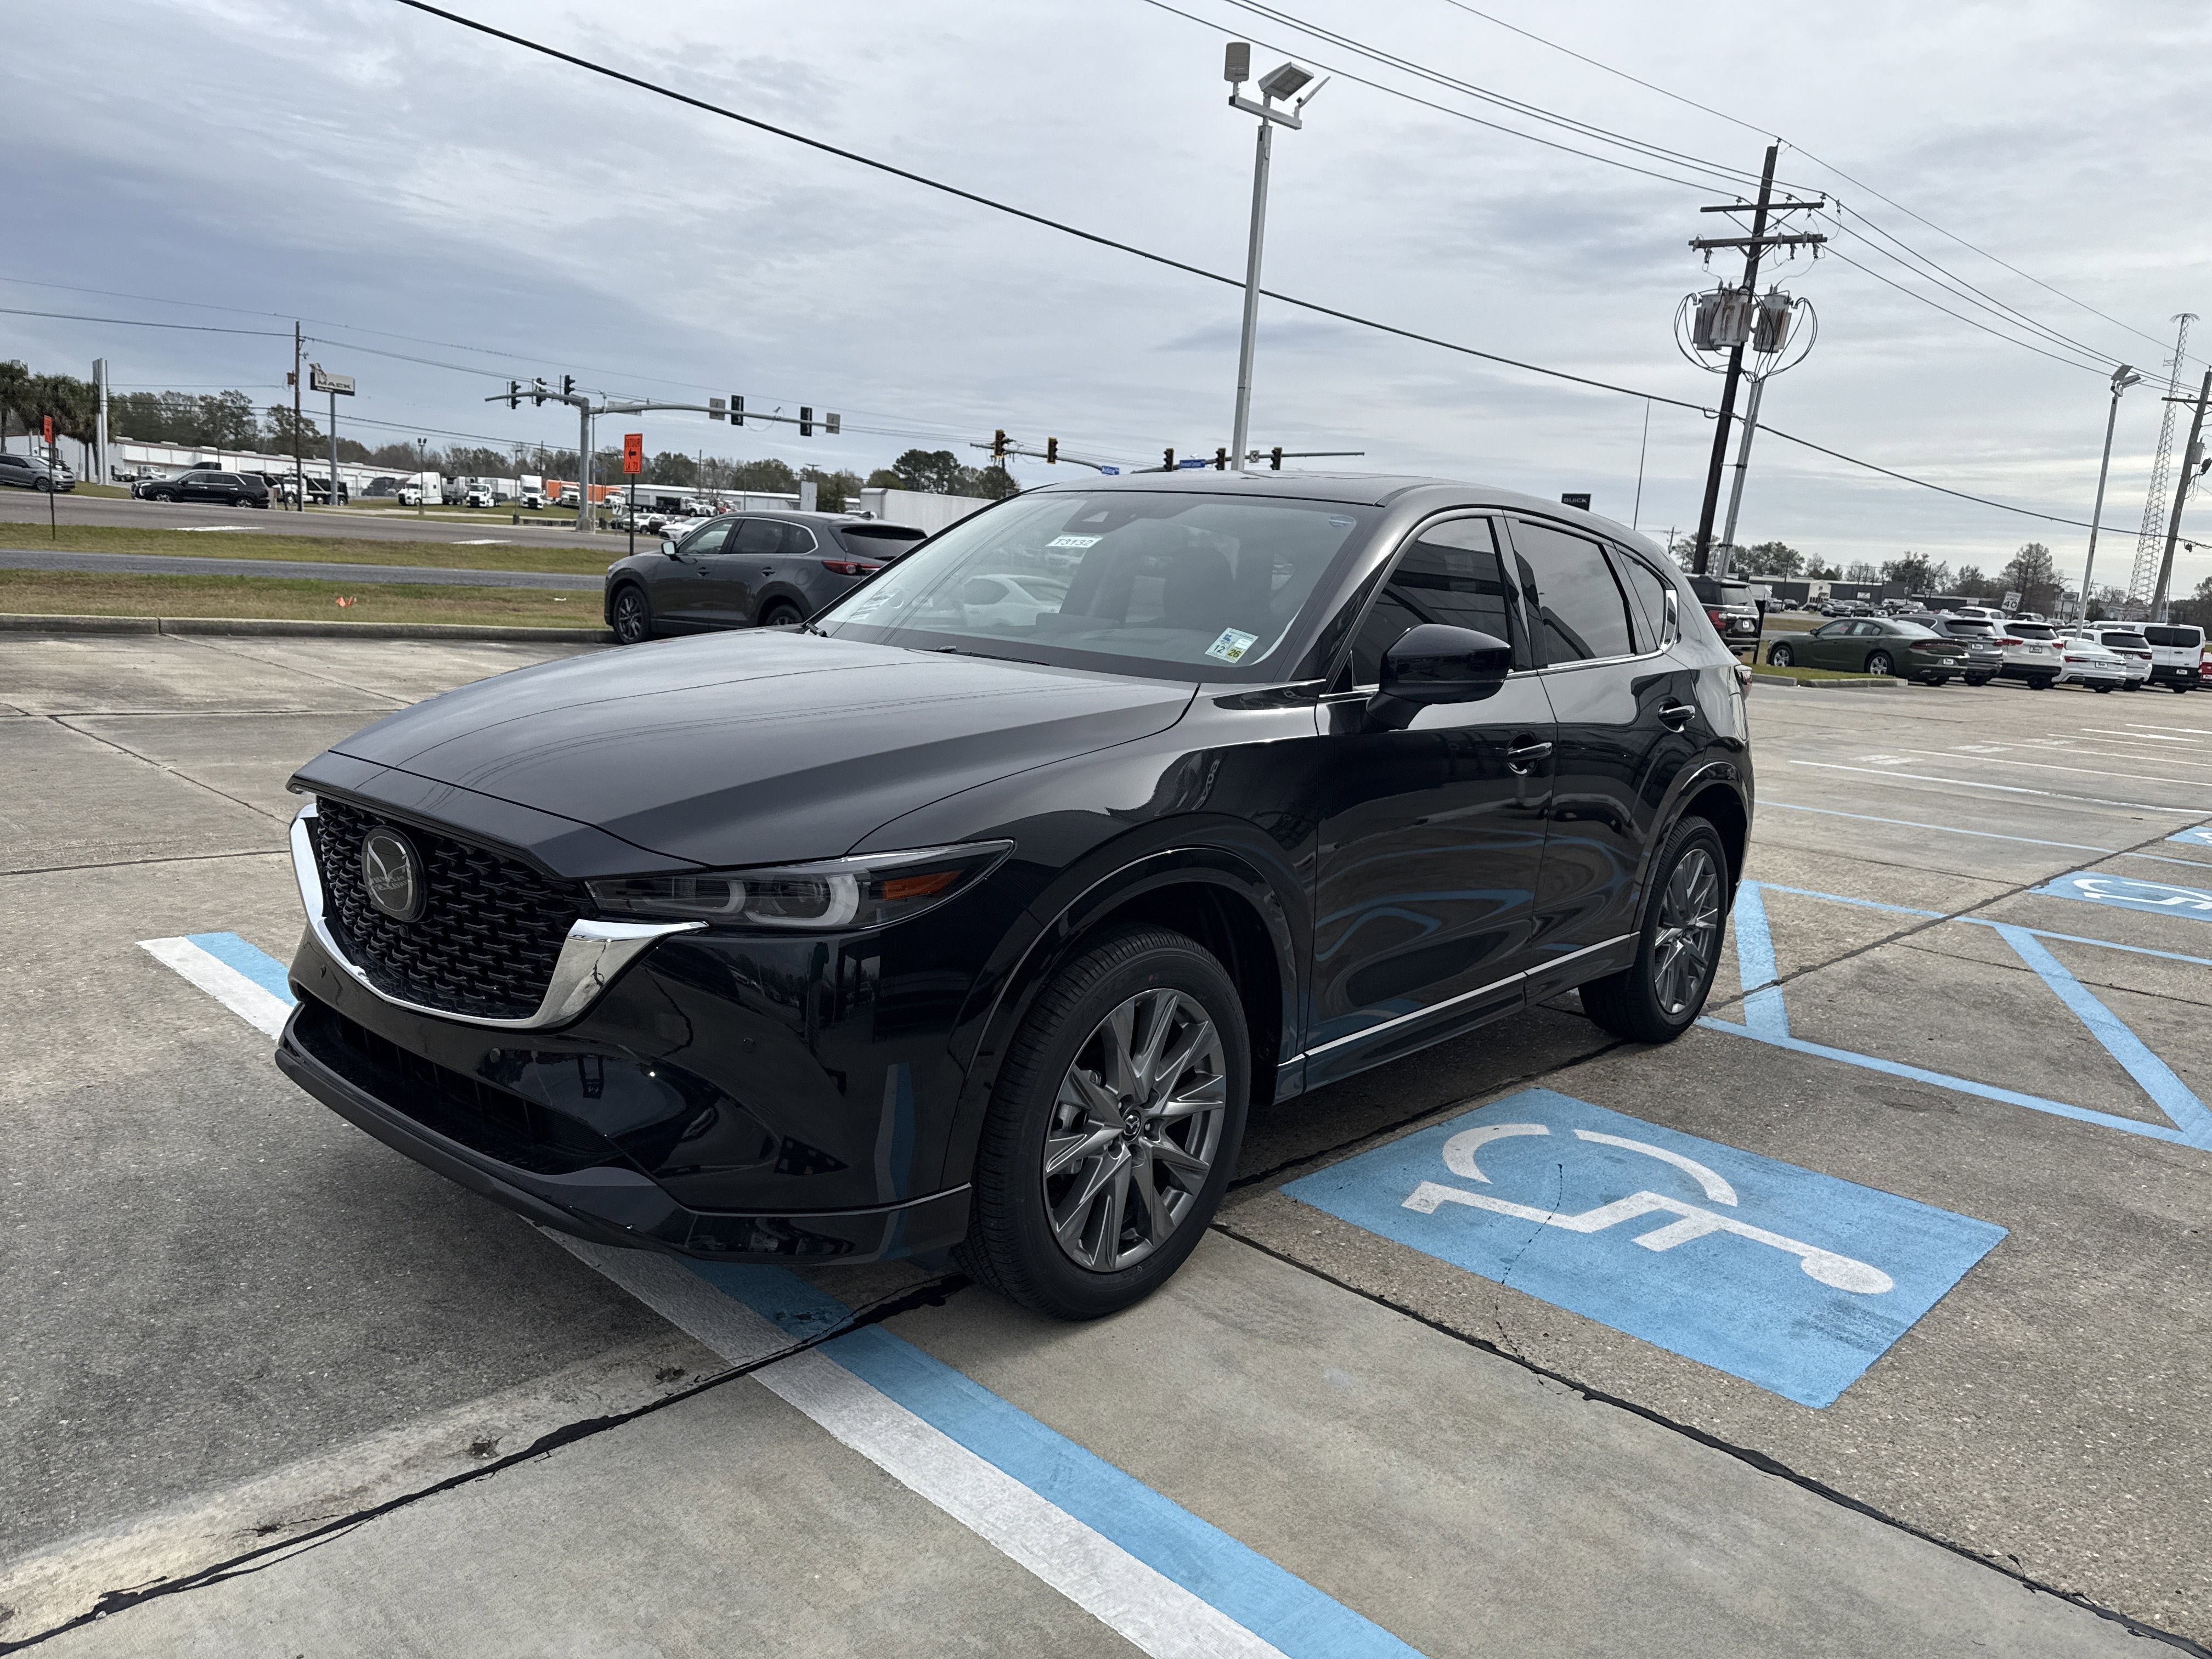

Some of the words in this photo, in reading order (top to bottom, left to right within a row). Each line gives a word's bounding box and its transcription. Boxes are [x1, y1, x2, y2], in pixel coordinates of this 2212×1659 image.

[318, 380, 351, 390] MACK
[1214, 645, 1226, 653] 12
[1228, 649, 1242, 658] 26
